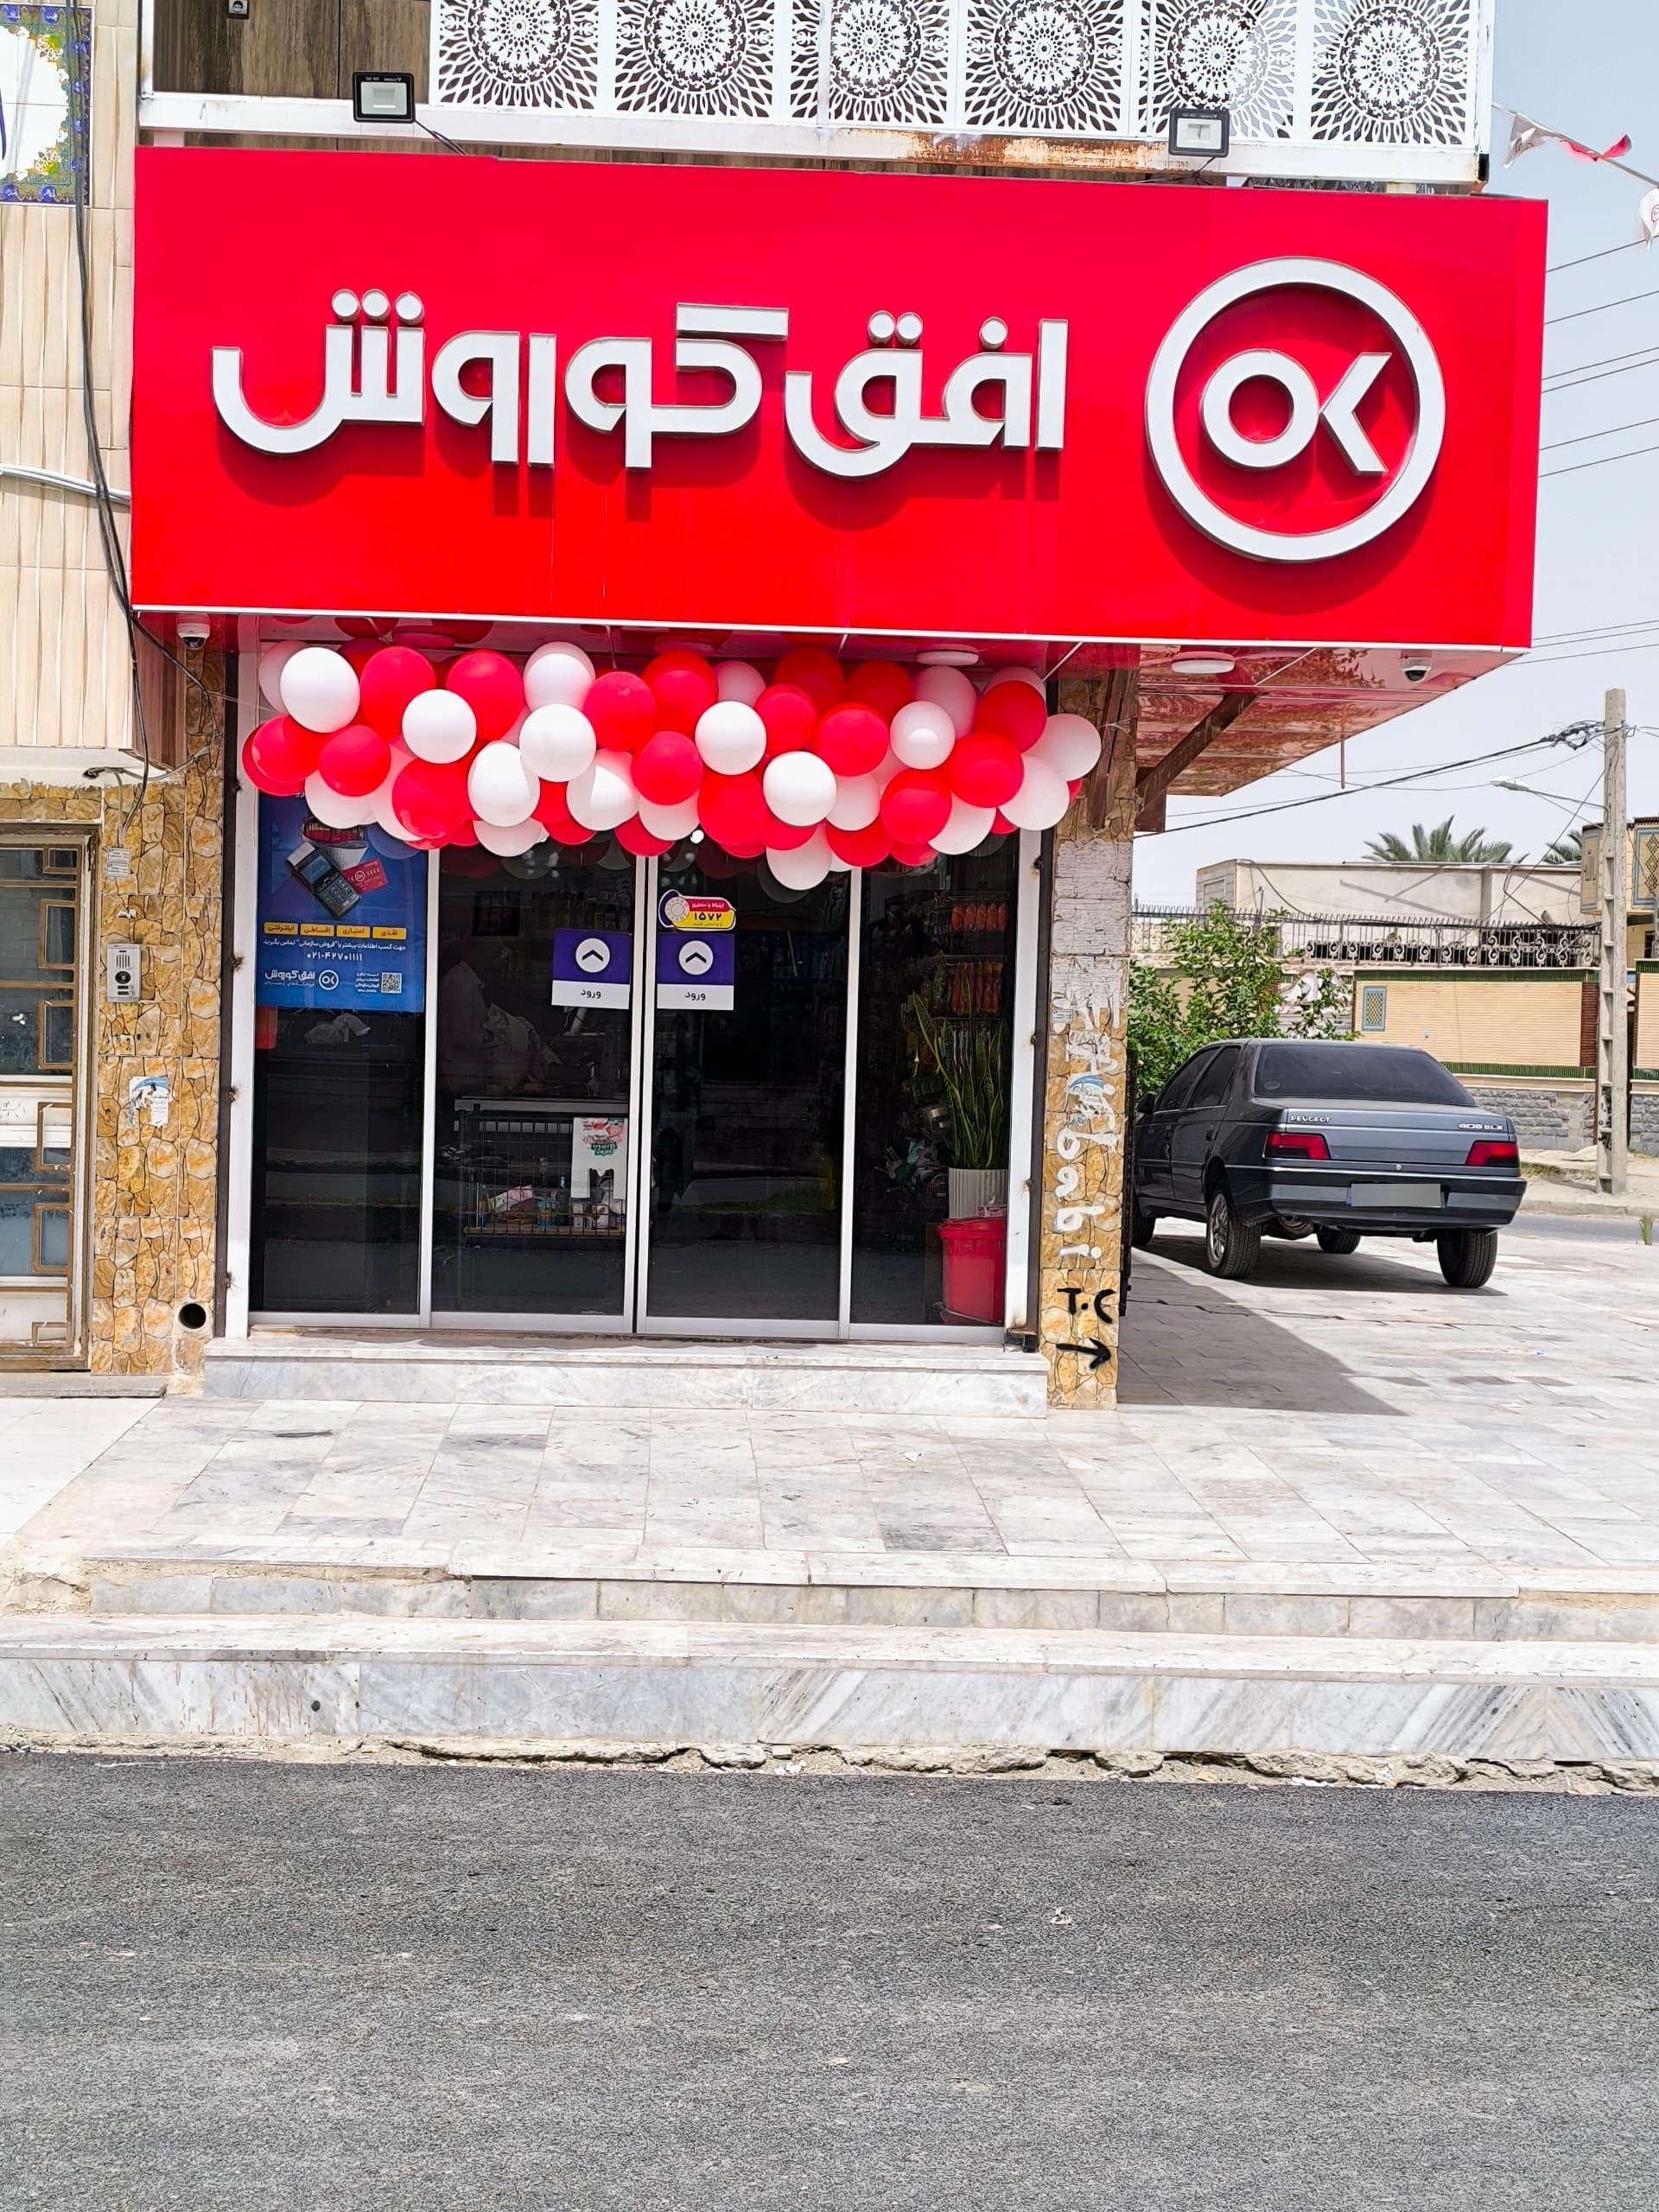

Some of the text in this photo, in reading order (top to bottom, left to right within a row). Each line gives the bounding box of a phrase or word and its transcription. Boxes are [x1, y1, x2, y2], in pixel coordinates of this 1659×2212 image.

[212, 289, 1069, 478] افق کوروش
[1200, 347, 1393, 475] OK
[694, 912, 722, 921] ۱۵۷۲
[264, 969, 316, 982] افق کوروش
[581, 988, 601, 999] ورود
[685, 990, 706, 1001] ورود
